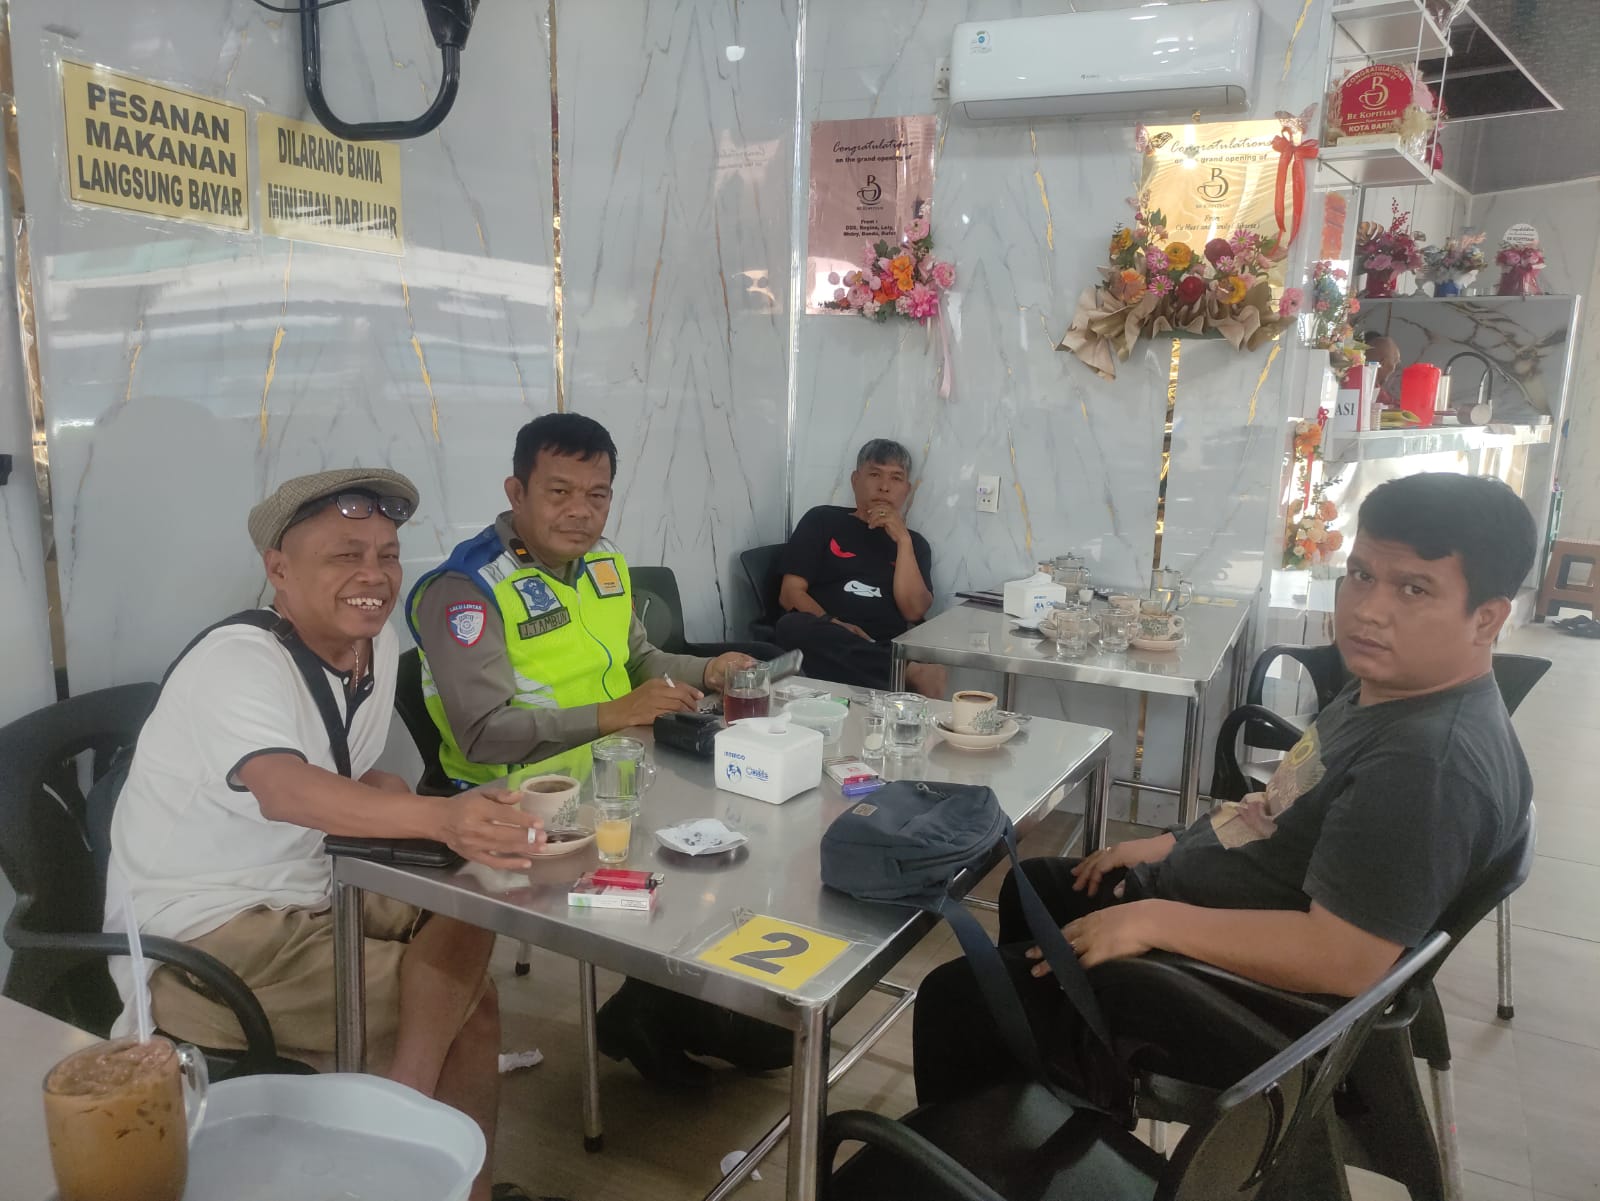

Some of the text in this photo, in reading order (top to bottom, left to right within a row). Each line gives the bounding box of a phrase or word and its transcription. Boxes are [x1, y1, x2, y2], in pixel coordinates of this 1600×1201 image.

[87, 82, 230, 144] PESANAN
[1348, 125, 1370, 133] KOTA
[85, 117, 237, 178] MAKANAN
[277, 127, 383, 185] DILARANG BAWA
[833, 138, 914, 156] Congratulations
[857, 155, 876, 163] grand
[1200, 156, 1223, 164] grand
[1225, 154, 1257, 163] opening
[77, 154, 243, 218] LANGSUNG BAYAR
[268, 183, 398, 240] MINUMAN DARI LUAR
[730, 932, 810, 975] 2
